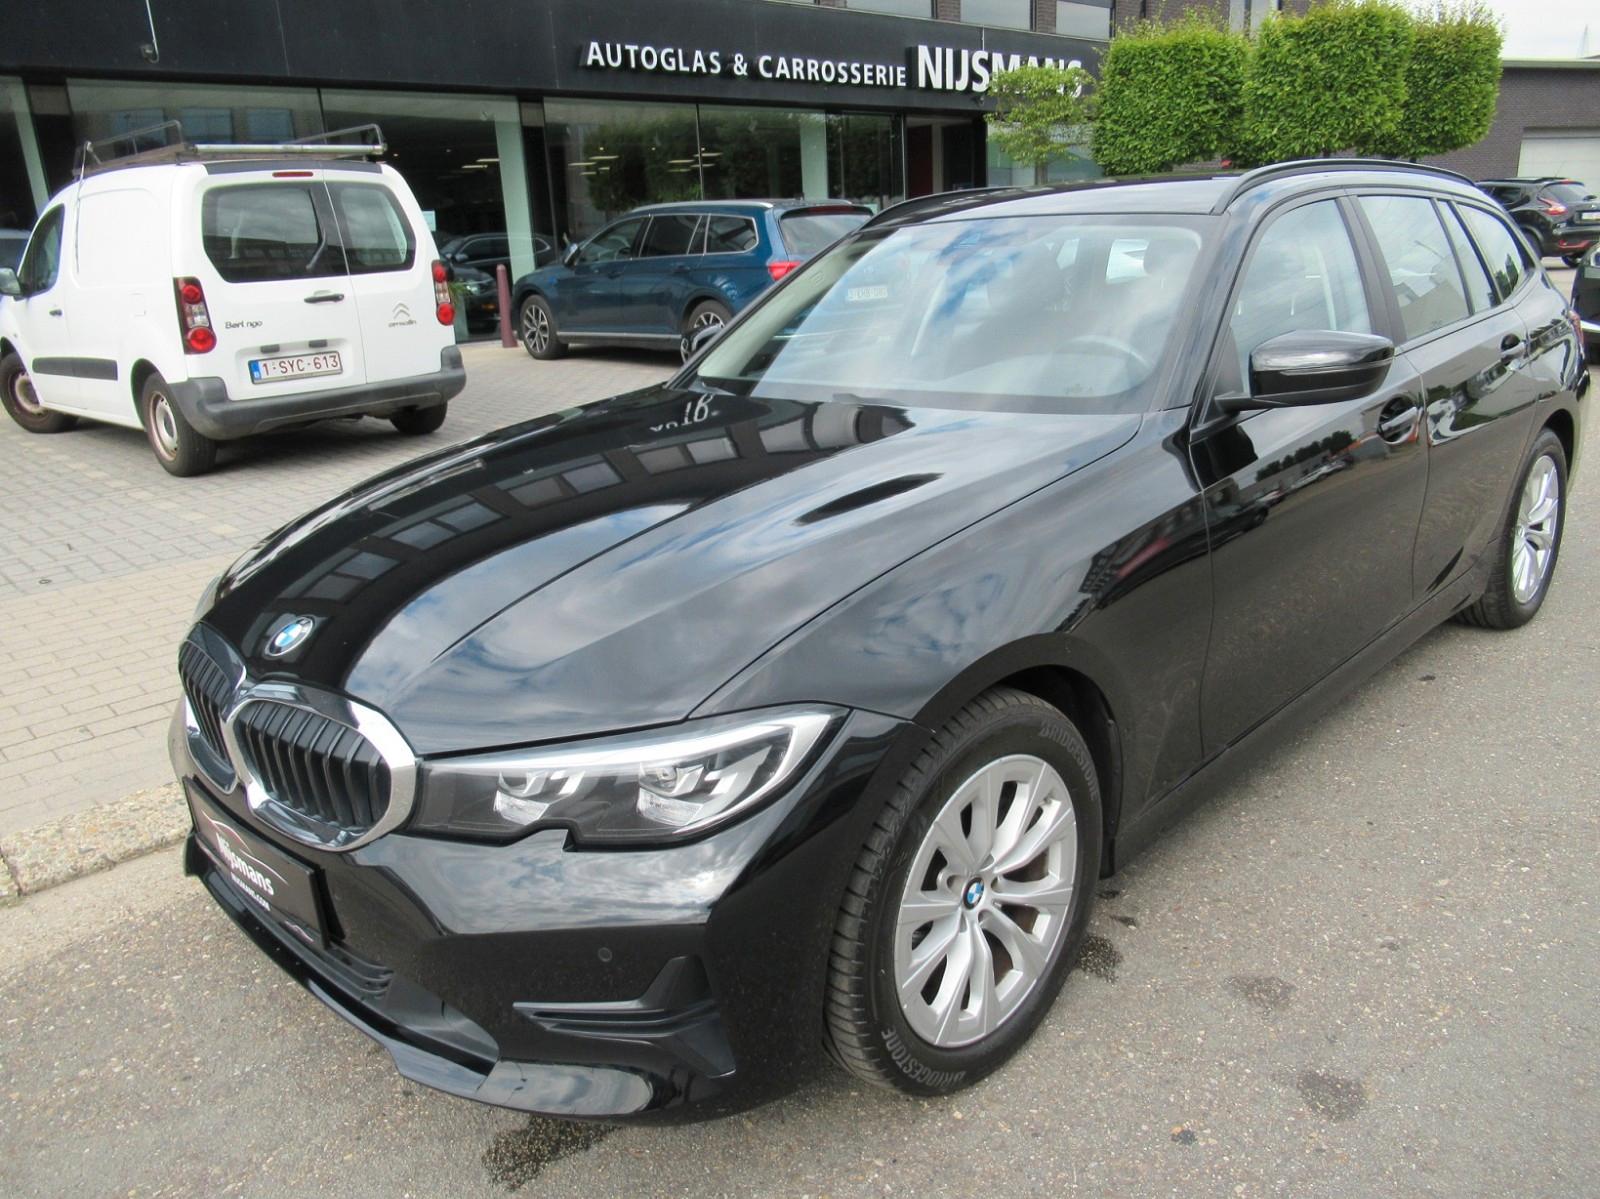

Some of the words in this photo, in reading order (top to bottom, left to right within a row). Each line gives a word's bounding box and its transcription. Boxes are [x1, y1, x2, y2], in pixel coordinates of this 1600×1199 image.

[586, 41, 722, 75] AUTOGLAS
[733, 53, 749, 76] &
[758, 55, 907, 87] CARROSSERIE
[225, 320, 263, 330] Berlngo
[1038, 719, 1100, 802] BRIDGESTONE
[880, 1025, 968, 1088] BRIDGESTONE
